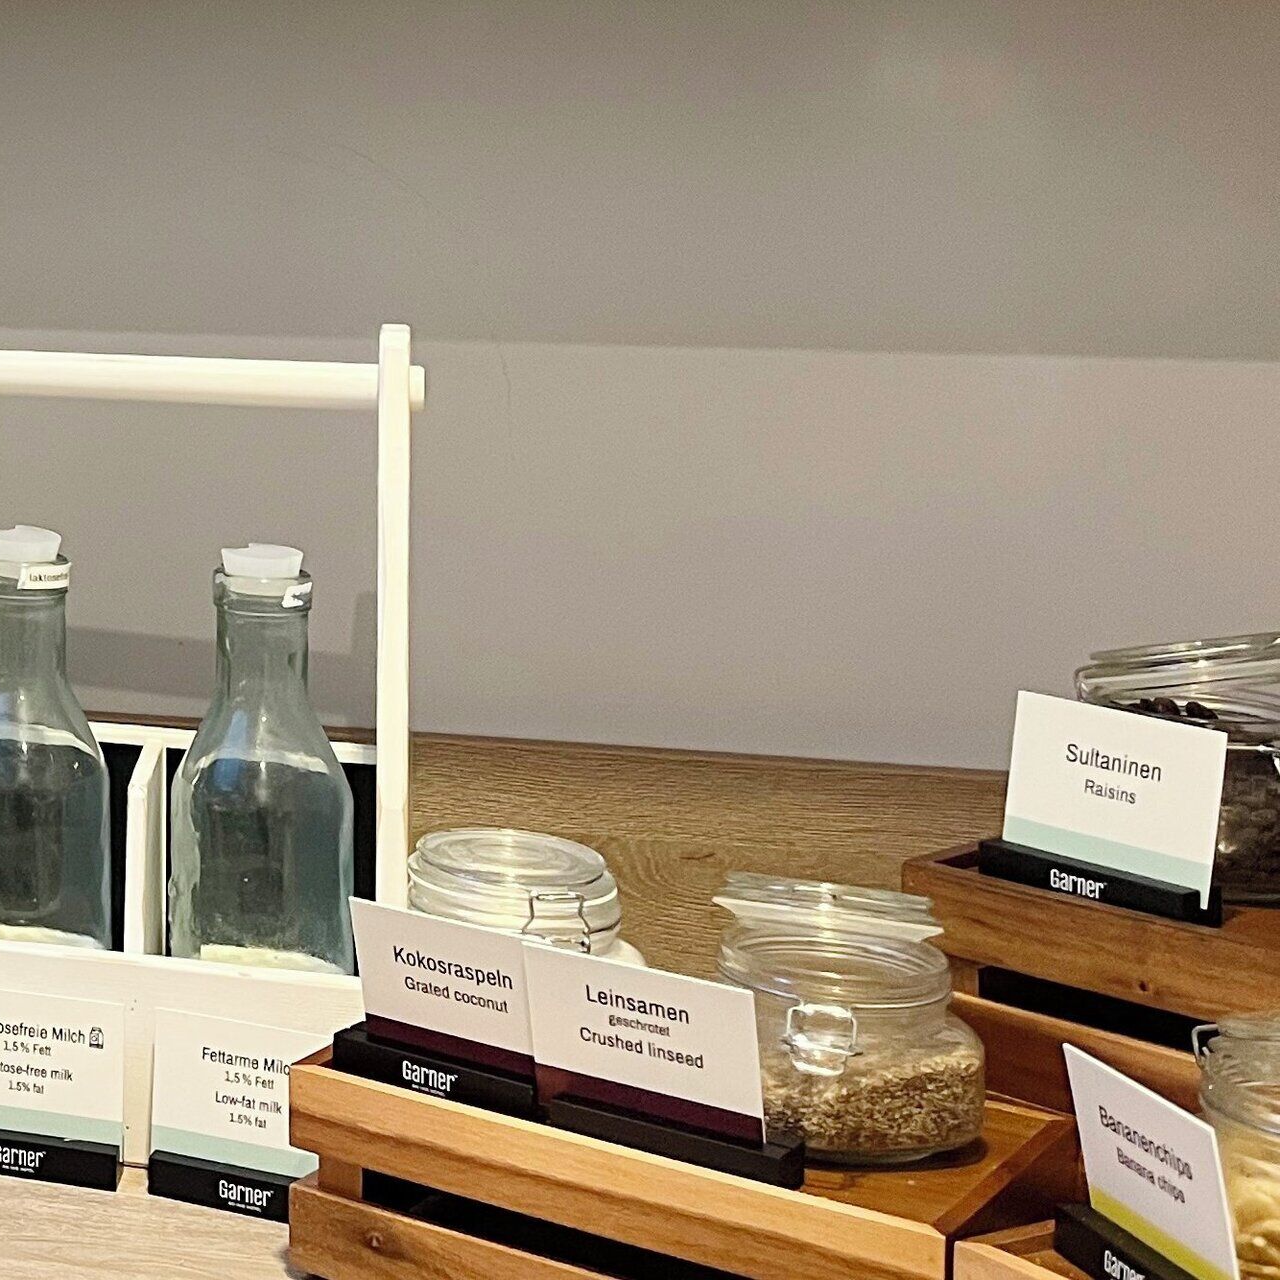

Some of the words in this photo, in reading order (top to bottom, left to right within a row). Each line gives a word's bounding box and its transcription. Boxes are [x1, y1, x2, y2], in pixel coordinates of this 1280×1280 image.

[1065, 743, 1162, 782] Sultaninen
[1084, 778, 1137, 805] Raisins
[1050, 868, 1105, 899] Garner
[393, 945, 514, 991] Kokosraspeln
[404, 976, 450, 1000] Grated
[454, 988, 509, 1014] coconut
[585, 984, 690, 1024] Leinsamen
[52, 1027, 86, 1044] Milch
[608, 1013, 671, 1038] geschrotet
[33, 1044, 52, 1056] Fett
[202, 1046, 259, 1070] Fettarme
[263, 1058, 290, 1076] Milc
[579, 1026, 643, 1056] Crushed
[648, 1042, 705, 1070] linseed
[33, 1083, 45, 1094] fat
[50, 1068, 73, 1081] milk
[255, 1076, 274, 1090] Fett
[402, 1060, 456, 1092] Garner
[215, 1091, 256, 1110] Low-fat
[259, 1100, 283, 1114] milk
[254, 1116, 267, 1129] fat
[1098, 1105, 1193, 1181] Bananenchips
[1116, 1146, 1156, 1185] Banana
[1157, 1175, 1186, 1204] chips
[219, 1179, 272, 1207] Garner
